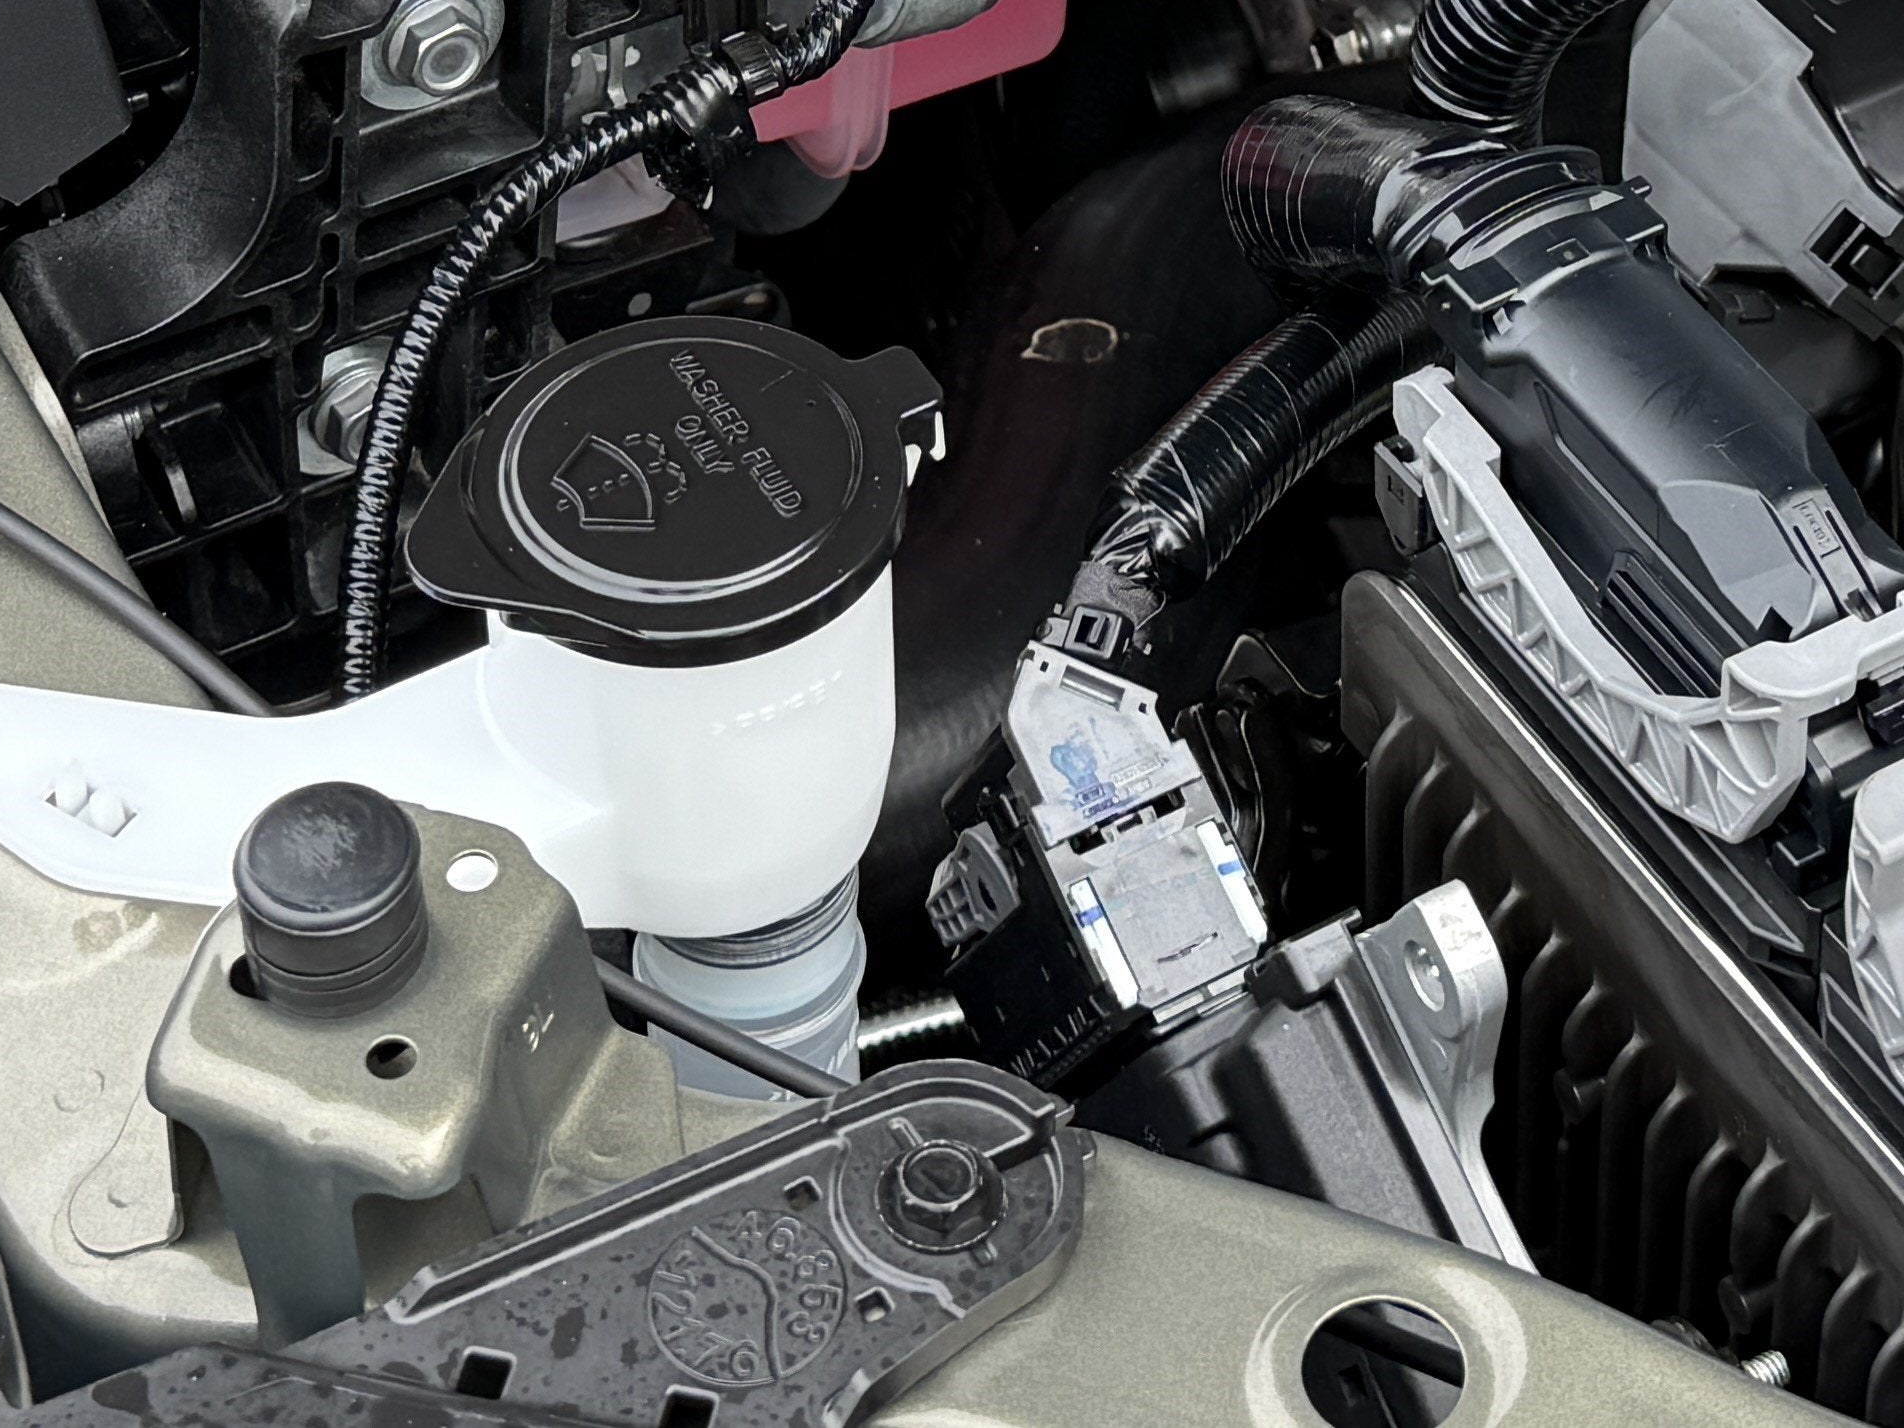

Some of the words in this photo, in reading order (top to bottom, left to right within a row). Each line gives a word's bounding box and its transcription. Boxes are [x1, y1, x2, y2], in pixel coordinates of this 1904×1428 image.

[669, 349, 751, 449] WASHER
[742, 444, 802, 520] FLUID
[675, 413, 733, 479] ONLY
